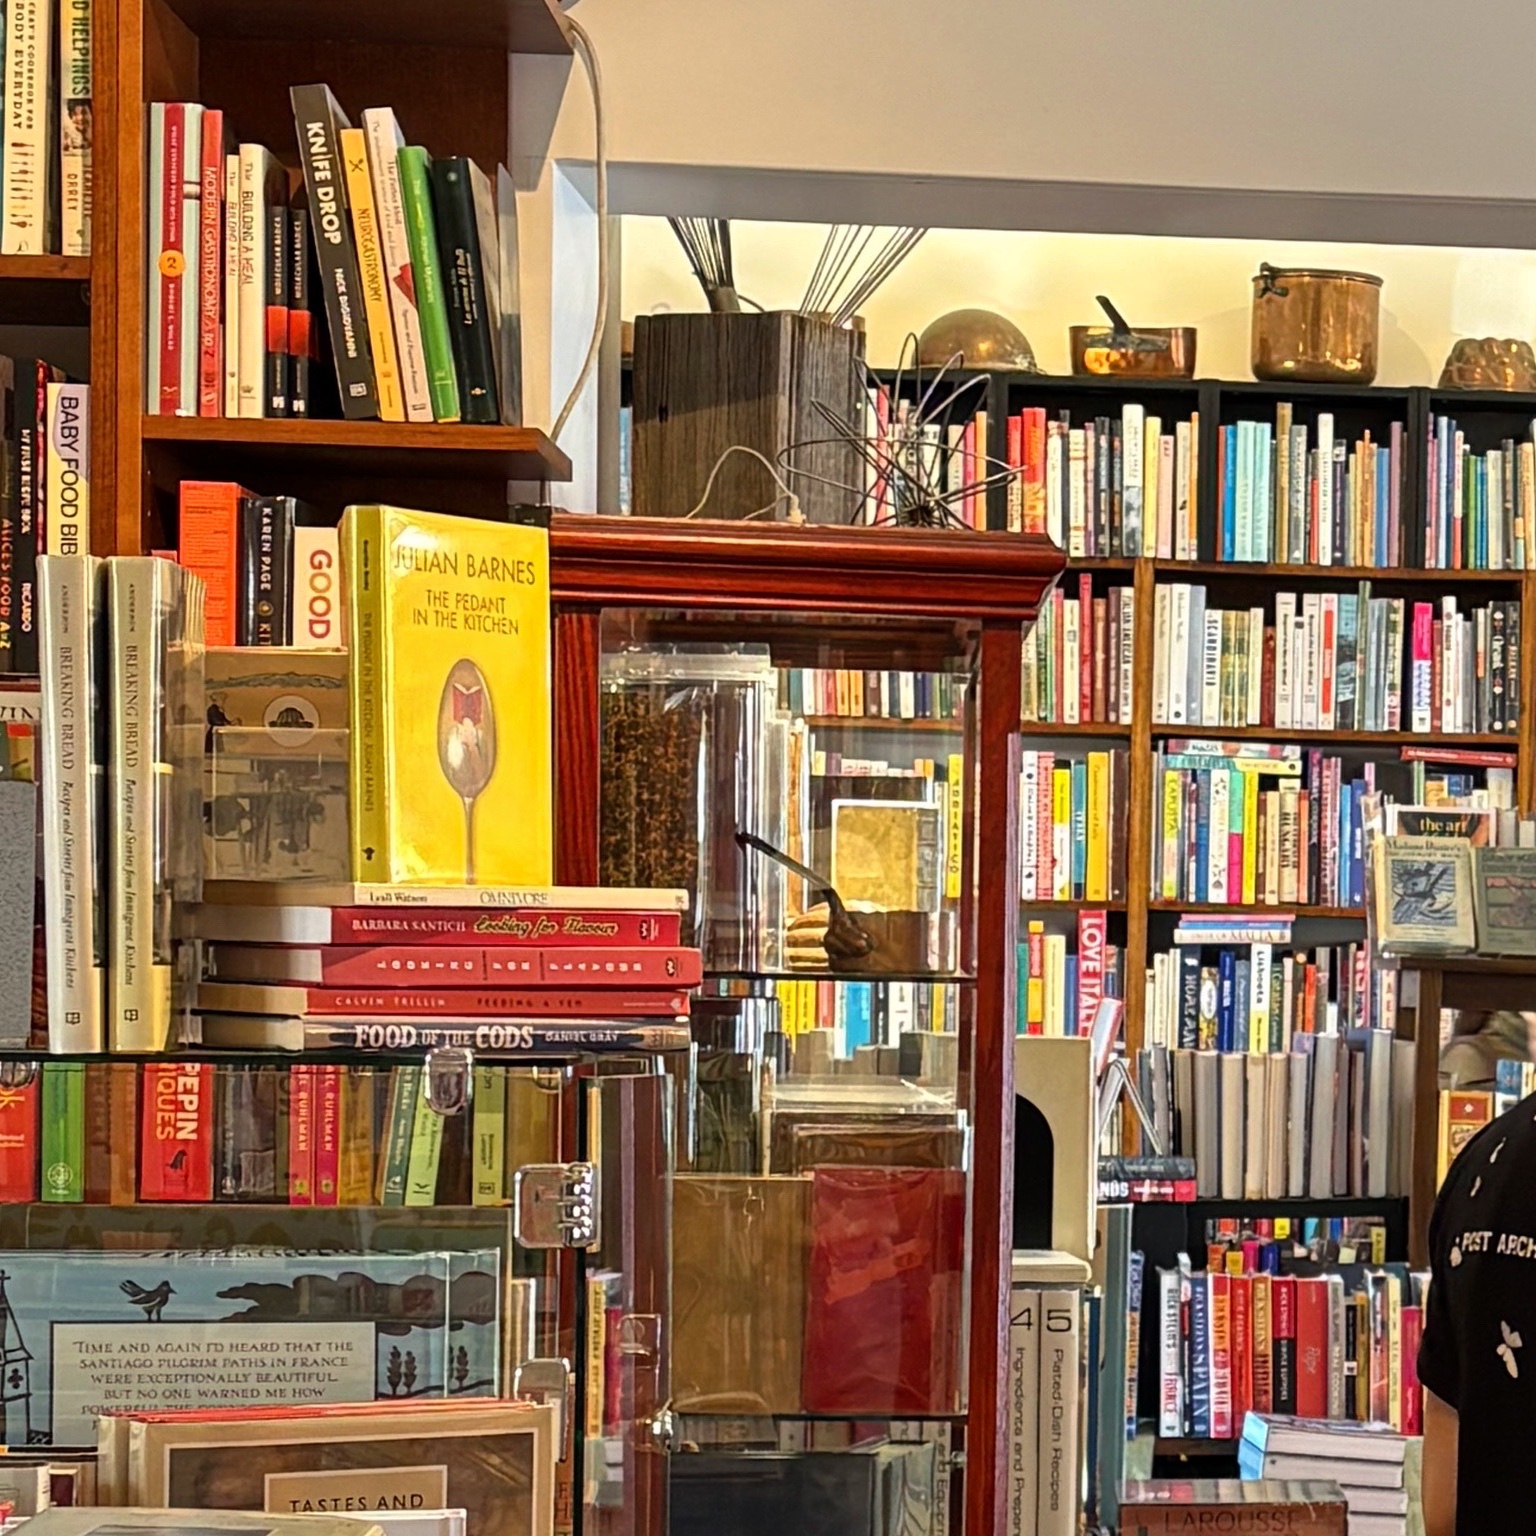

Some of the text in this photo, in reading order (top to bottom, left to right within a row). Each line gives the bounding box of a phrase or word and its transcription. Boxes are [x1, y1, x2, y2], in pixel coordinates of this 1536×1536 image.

[72, 17, 91, 96] HELPINGS
[13, 50, 25, 130] EVERYDAY
[204, 166, 217, 222] MODERN
[242, 190, 254, 242] BUILDING
[315, 186, 342, 245] DROP
[204, 227, 217, 319] GASTRONOMY
[358, 208, 382, 303] NEUROGASTRONOMY
[60, 396, 79, 453] BABY
[60, 457, 79, 518] FOOD
[260, 507, 272, 591] KAREN PAGE
[393, 543, 536, 585] JULIAN BARNES
[21, 582, 33, 632] RICARDO
[308, 549, 333, 639] GOOD
[426, 588, 506, 615] THE PEDANT
[412, 608, 519, 635] IN THE KITCHEN
[60, 646, 74, 718] BREAKING
[125, 645, 139, 717] BREAKING
[61, 723, 75, 770] BREAD
[125, 721, 139, 768] BREAD
[63, 818, 74, 835] and
[125, 815, 135, 833] and
[1419, 817, 1467, 832] the art
[60, 871, 75, 891] from
[122, 868, 136, 889] from
[479, 891, 549, 905] OMNIVORE
[352, 919, 409, 932] BARBARA
[412, 919, 467, 933] SANTICH
[1081, 918, 1101, 973] LOVE
[354, 1024, 417, 1049] FOOD
[420, 1030, 440, 1046] OF
[323, 1092, 335, 1152] RUHLMAN
[1461, 1230, 1493, 1253] POST
[1009, 1306, 1034, 1331] 4
[72, 1340, 113, 1354] TIME
[117, 1341, 150, 1354] AND
[155, 1341, 201, 1354] AGAIN
[229, 1341, 280, 1354] HEARD
[285, 1341, 321, 1353] THAT
[326, 1341, 354, 1353] THE
[79, 1356, 349, 1370] SANTIAGO PILGRIM PATHS IN FRANCE
[91, 1372, 339, 1385] WERE EXCEPTIONALLY BEAUTIFUL
[104, 1387, 327, 1400] BUT NO ONE WARNED ME HOW
[1012, 1346, 1026, 1436] Ingredients
[1193, 1353, 1208, 1417] SPAIN
[1045, 1308, 1073, 1513] 5 Recipes
[1013, 1442, 1024, 1472] and
[289, 1493, 424, 1513] TASTES AND
[1164, 1511, 1296, 1533] LAROUSSE
